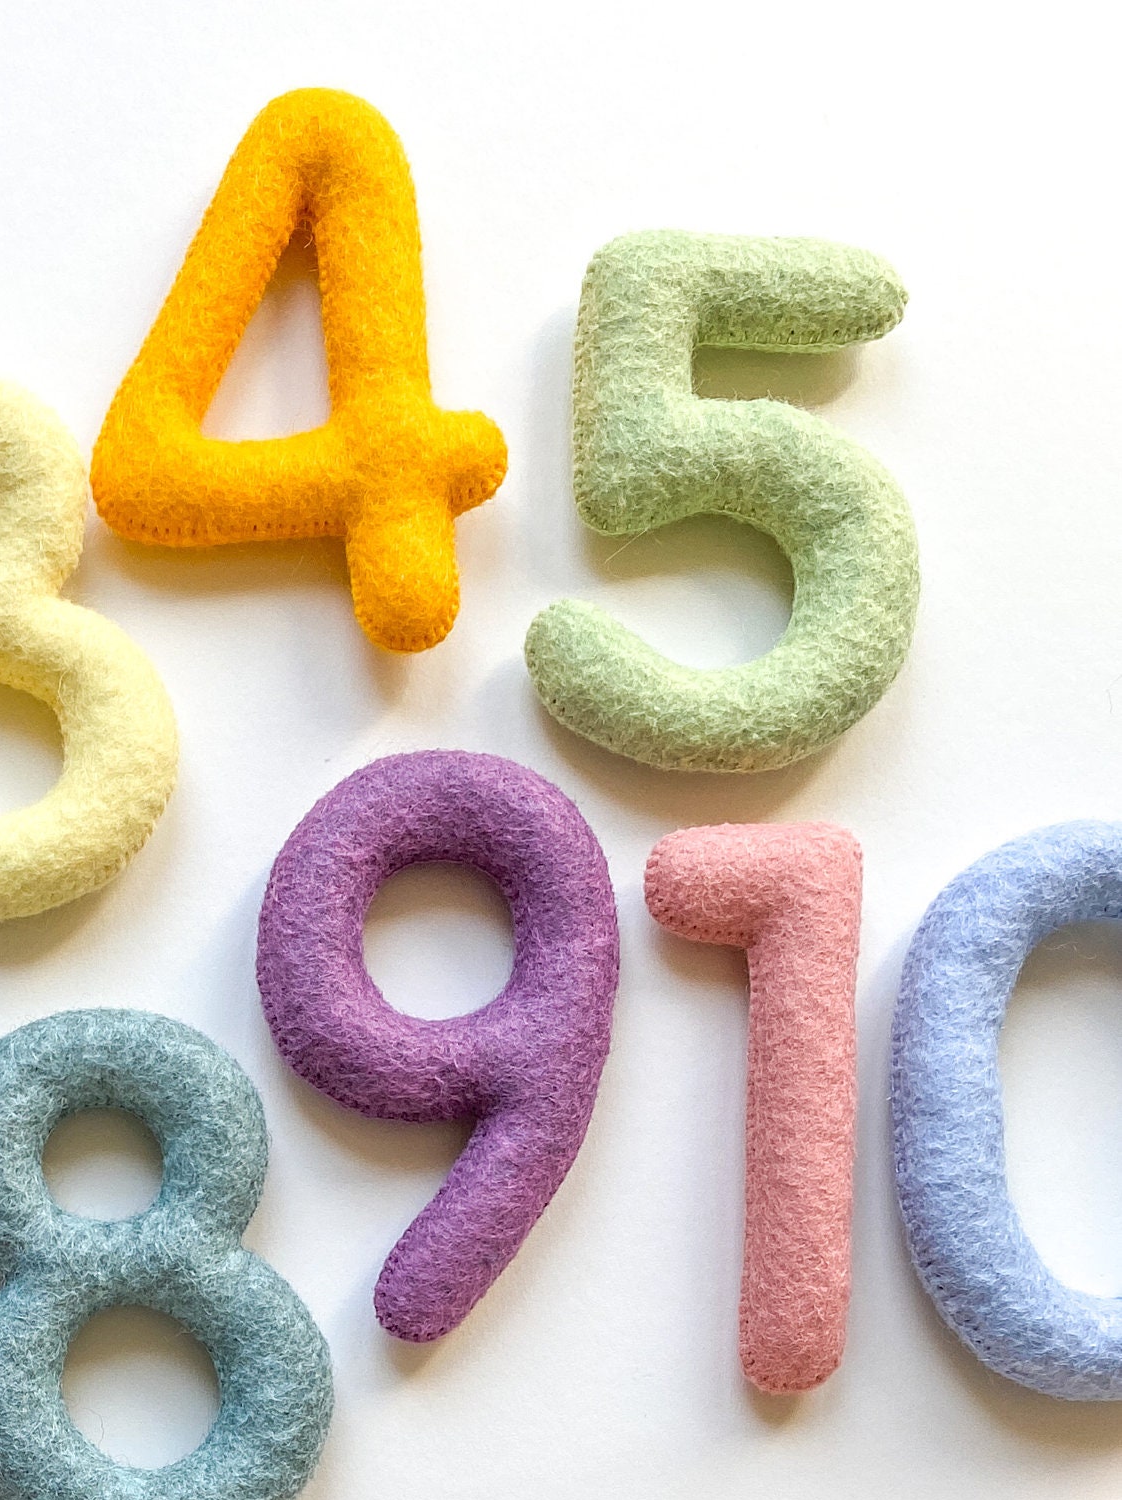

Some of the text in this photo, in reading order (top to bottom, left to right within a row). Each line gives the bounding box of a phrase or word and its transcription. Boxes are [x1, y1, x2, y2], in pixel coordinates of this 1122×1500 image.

[91, 86, 508, 653] 4
[525, 230, 920, 774] 5
[257, 750, 620, 1342] 9
